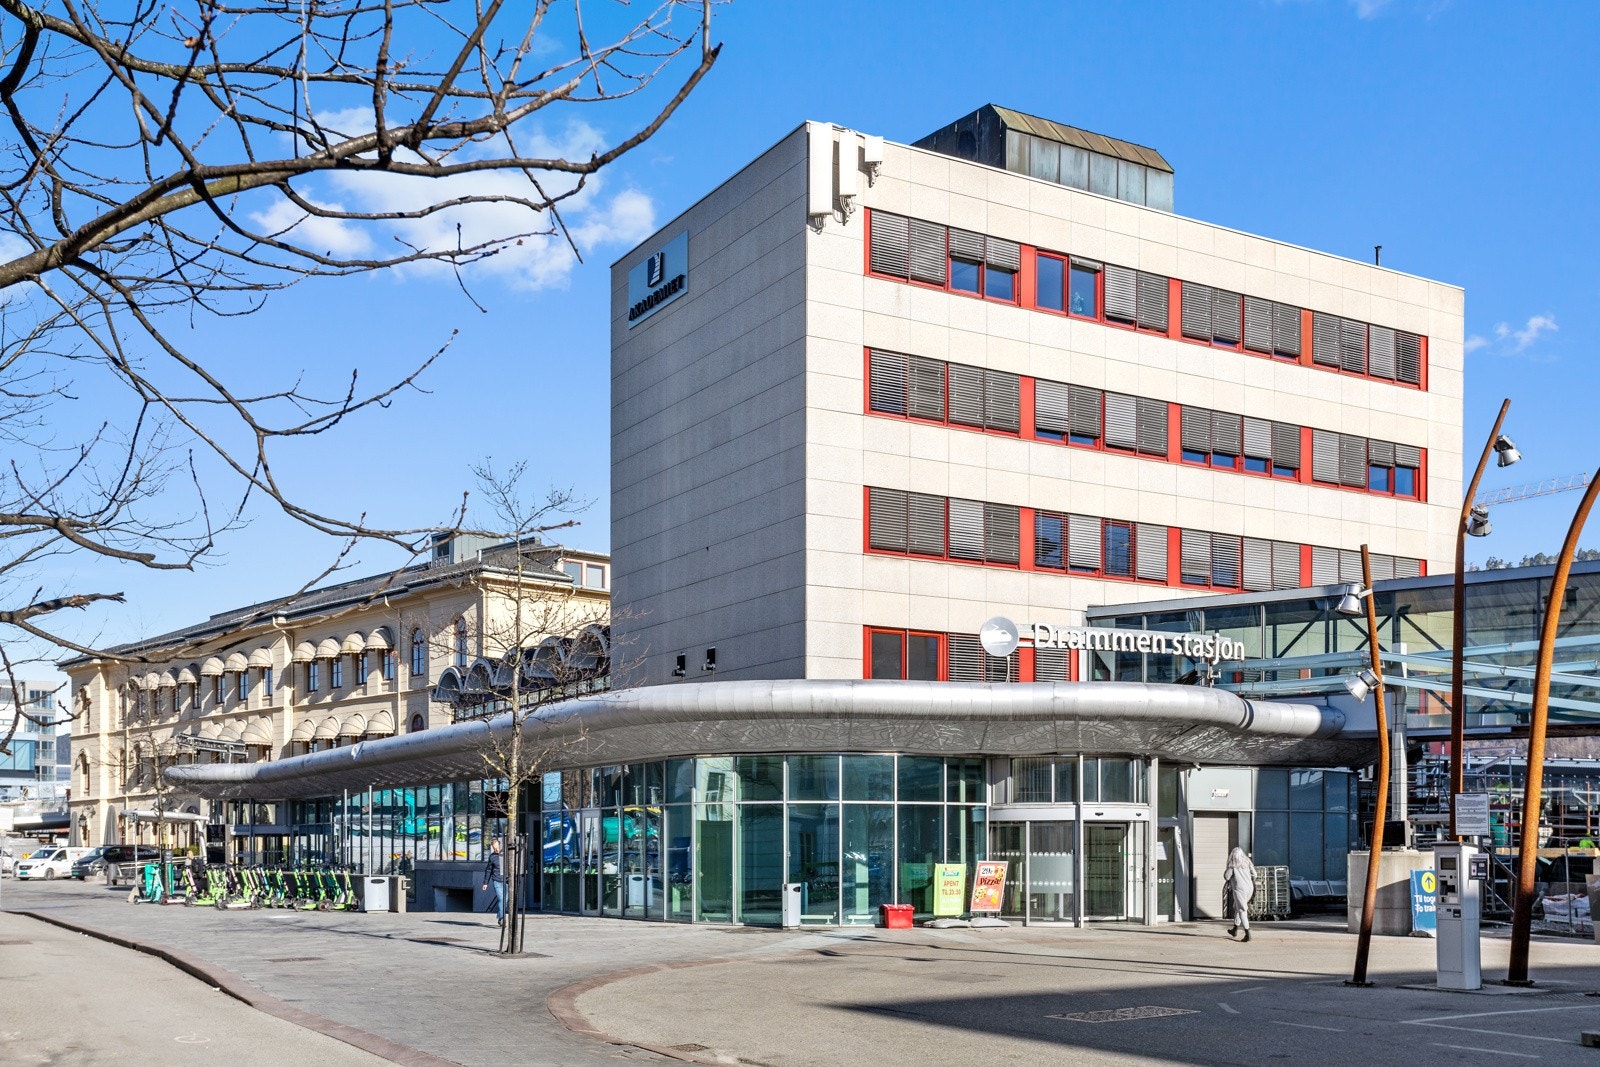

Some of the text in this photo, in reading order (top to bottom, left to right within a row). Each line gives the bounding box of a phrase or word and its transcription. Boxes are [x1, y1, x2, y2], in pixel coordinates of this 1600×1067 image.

[629, 274, 686, 321] AKADEMIET
[1033, 622, 1245, 665] Drammen stasjon
[1414, 903, 1423, 912] To
